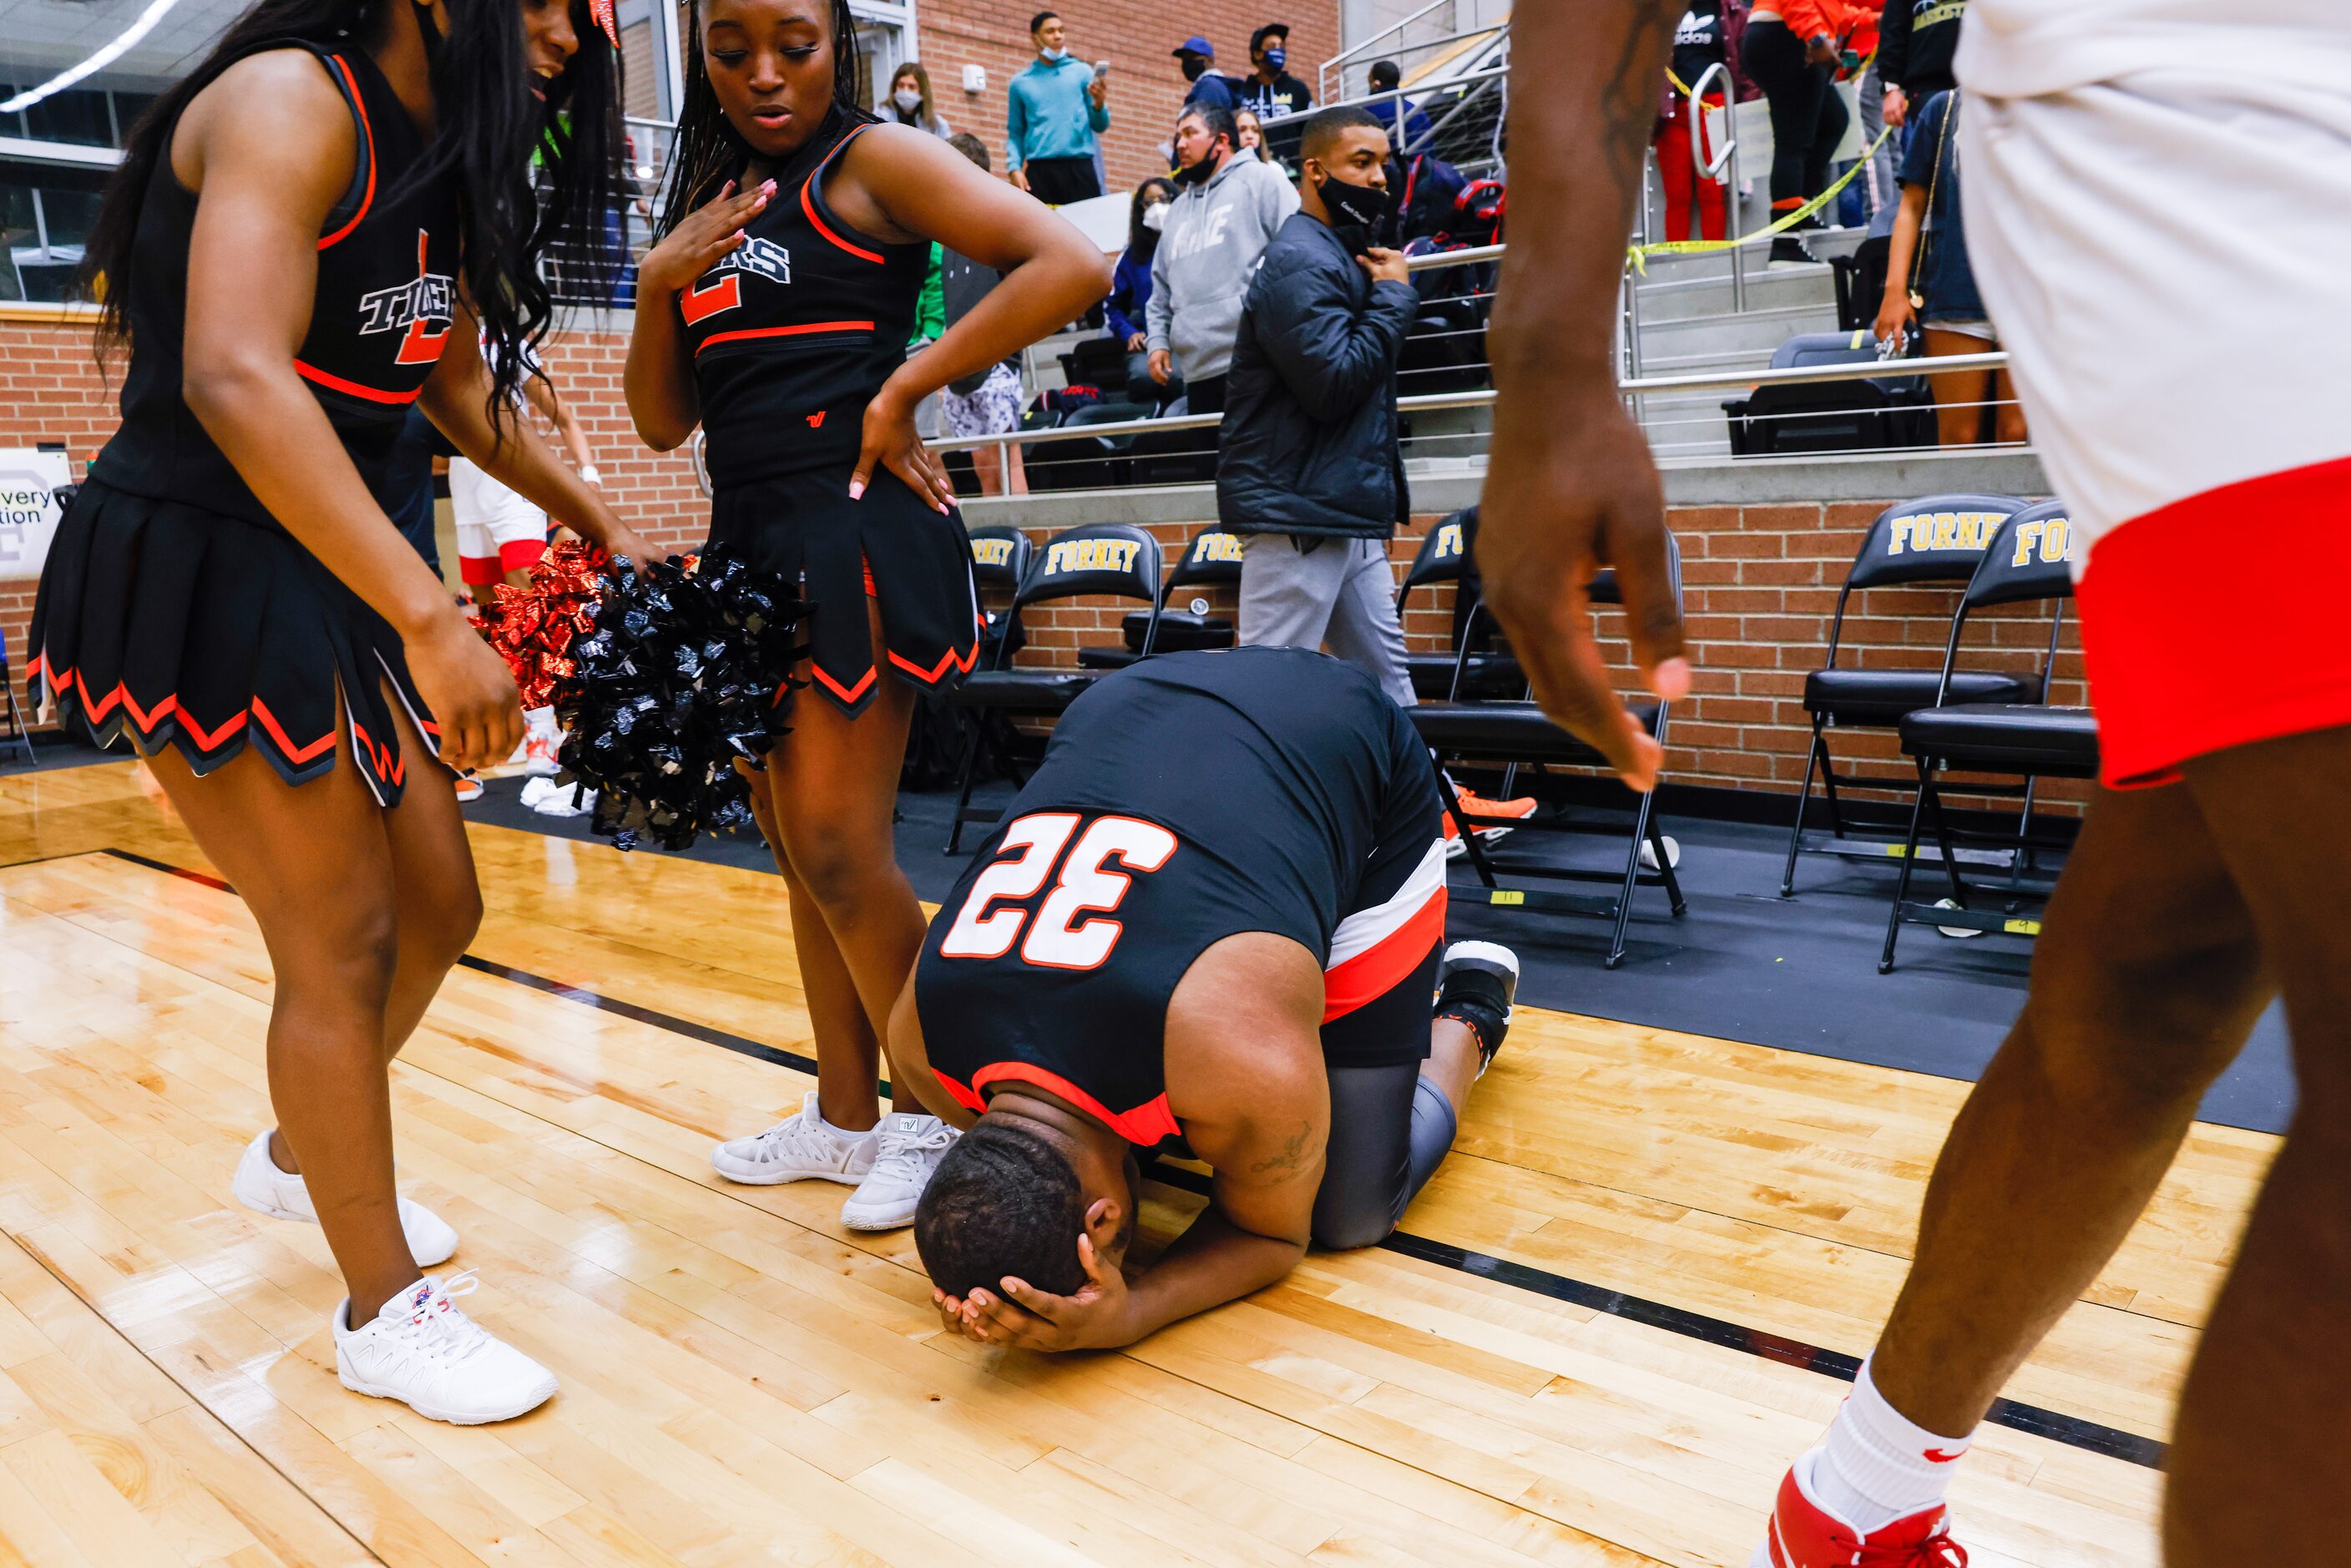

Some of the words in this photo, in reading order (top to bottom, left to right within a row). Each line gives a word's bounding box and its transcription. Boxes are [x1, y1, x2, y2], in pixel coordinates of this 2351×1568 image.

[1673, 30, 1713, 45] idas
[1888, 512, 2010, 555] FORNE
[2011, 518, 2075, 568] FO
[1044, 539, 1141, 576] FORNEY
[939, 812, 1179, 971] 32
